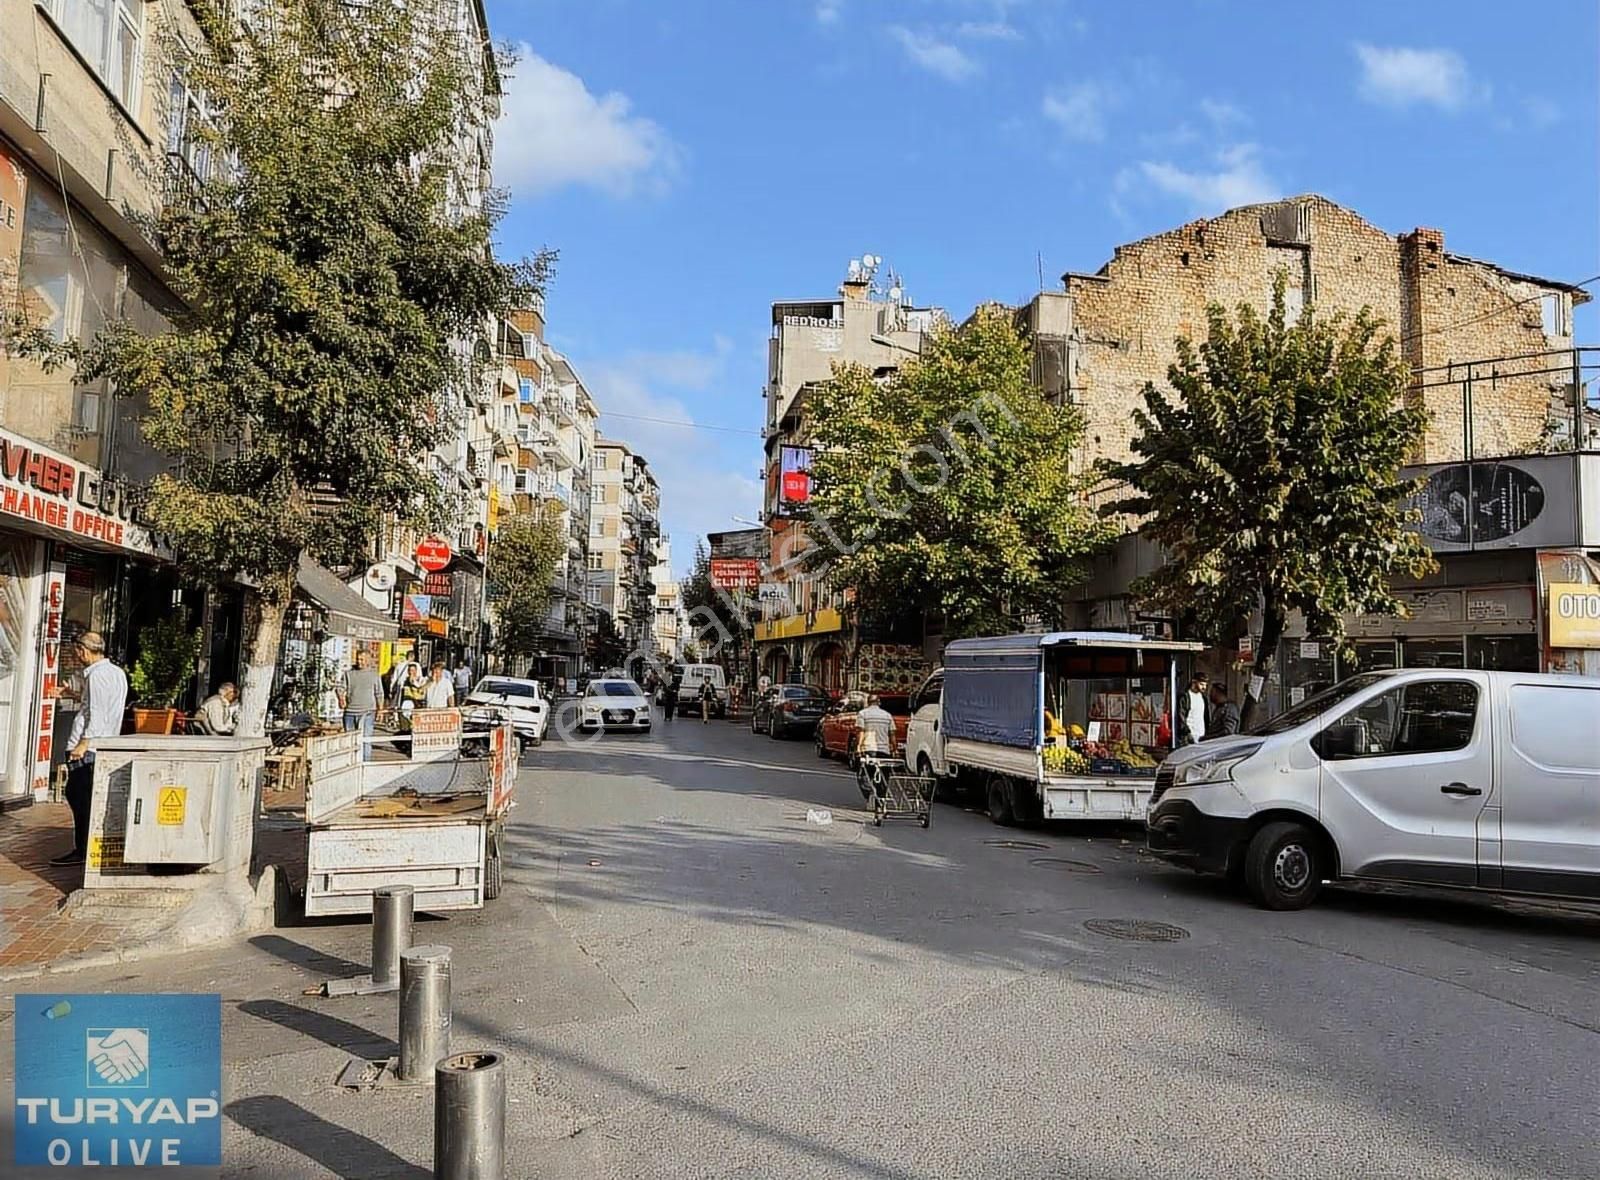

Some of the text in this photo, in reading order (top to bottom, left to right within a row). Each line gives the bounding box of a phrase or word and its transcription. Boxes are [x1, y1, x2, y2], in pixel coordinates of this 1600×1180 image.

[783, 315, 845, 329] RED ROSE
[0, 437, 76, 501] VHER
[0, 484, 124, 545] HANGE OFFICE
[714, 577, 757, 587] CLINIC
[37, 581, 62, 763] CEVHER
